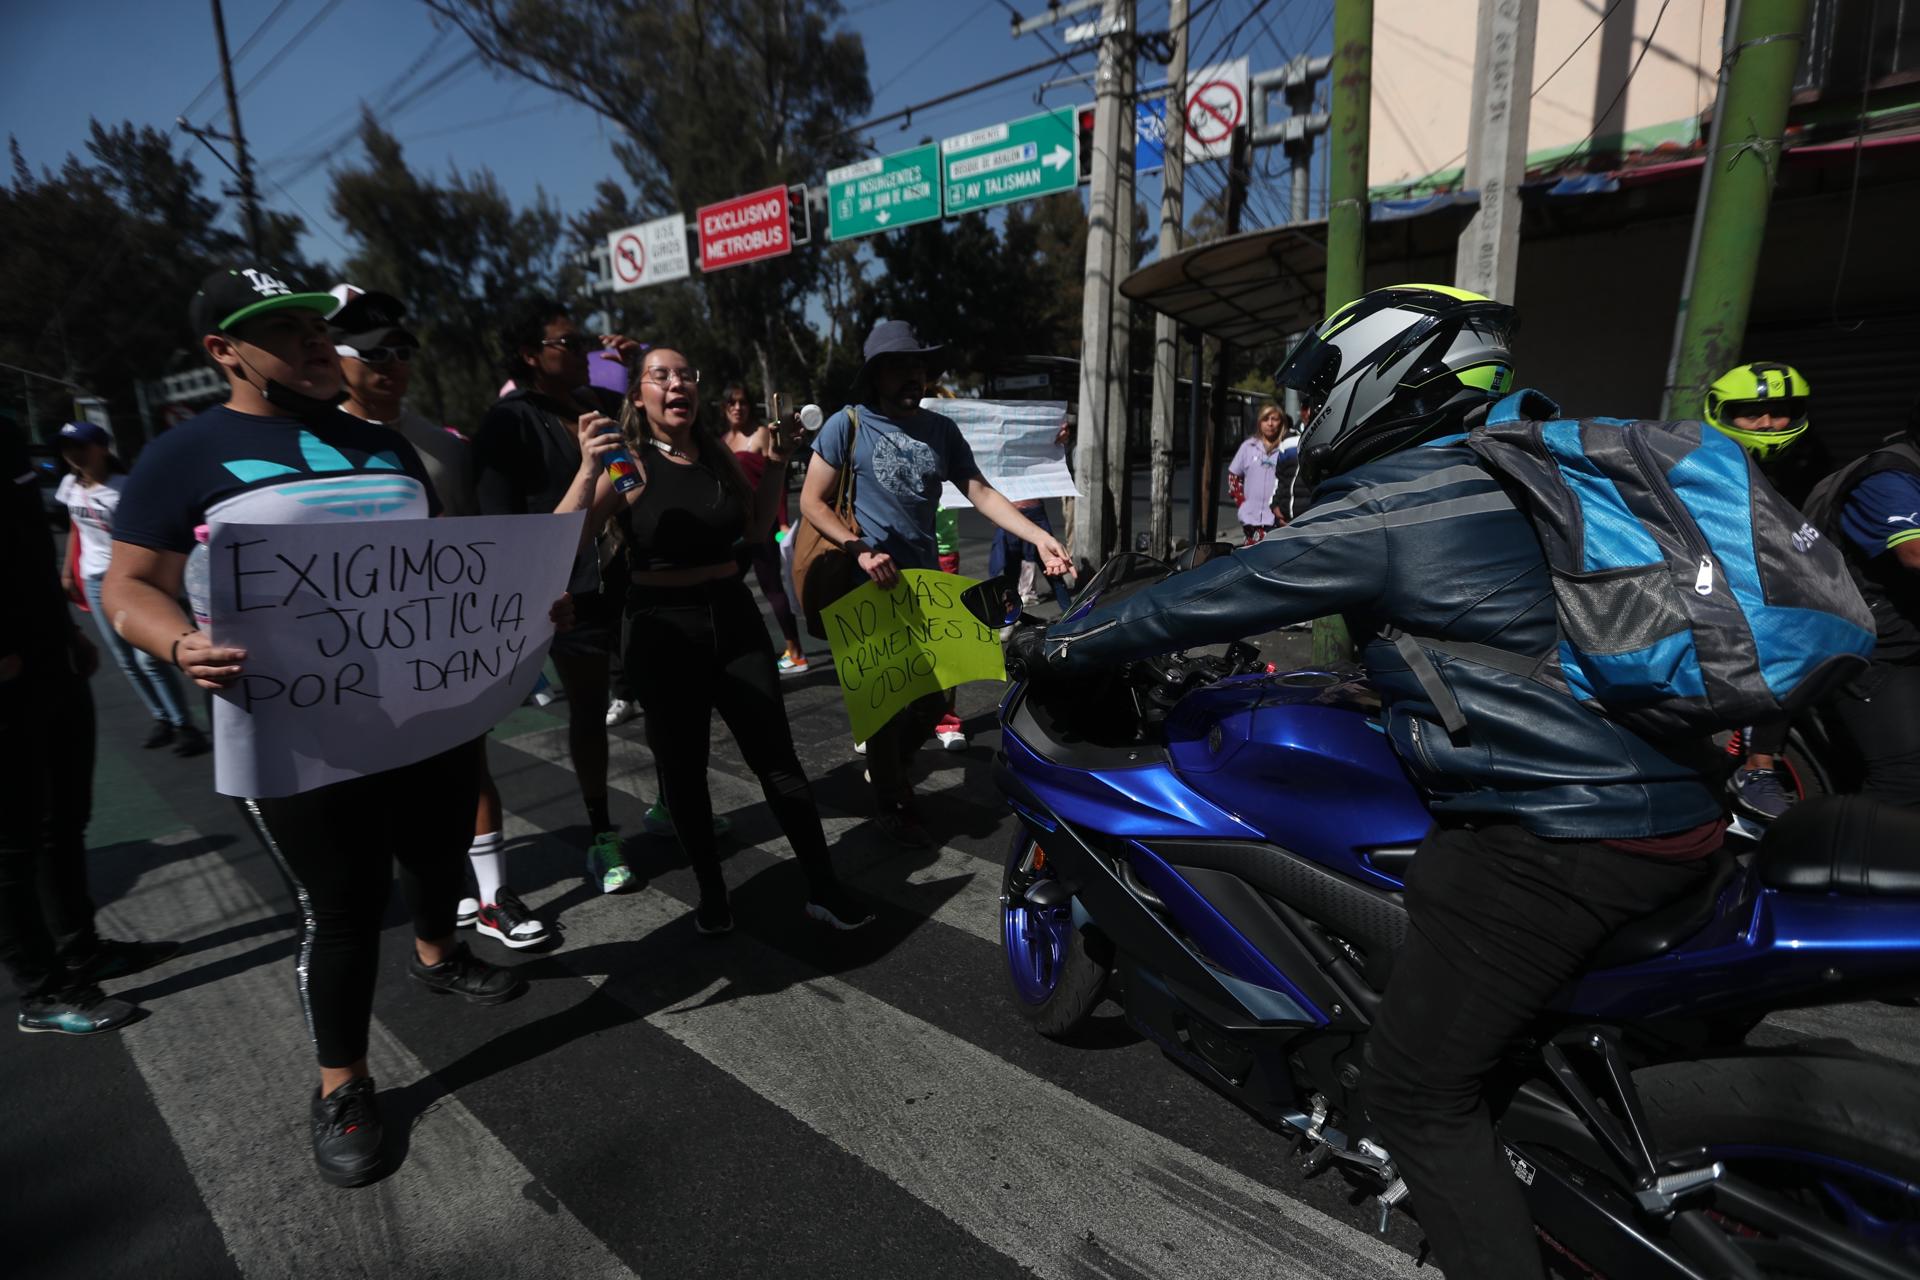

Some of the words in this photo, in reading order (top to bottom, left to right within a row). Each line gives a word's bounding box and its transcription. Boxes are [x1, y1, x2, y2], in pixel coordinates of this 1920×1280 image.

[966, 181, 981, 200] AV
[984, 167, 1041, 196] TALISMAN
[704, 198, 782, 236] EXCLUSIVO
[706, 226, 783, 260] METROBUS
[225, 538, 497, 612] EXIGIMOS
[296, 591, 525, 658] JUSTICIA
[834, 599, 877, 649] NO
[841, 617, 963, 692] CRIMENES
[241, 661, 384, 714] POR
[406, 635, 527, 693] DANY
[870, 648, 937, 710] ODIO
